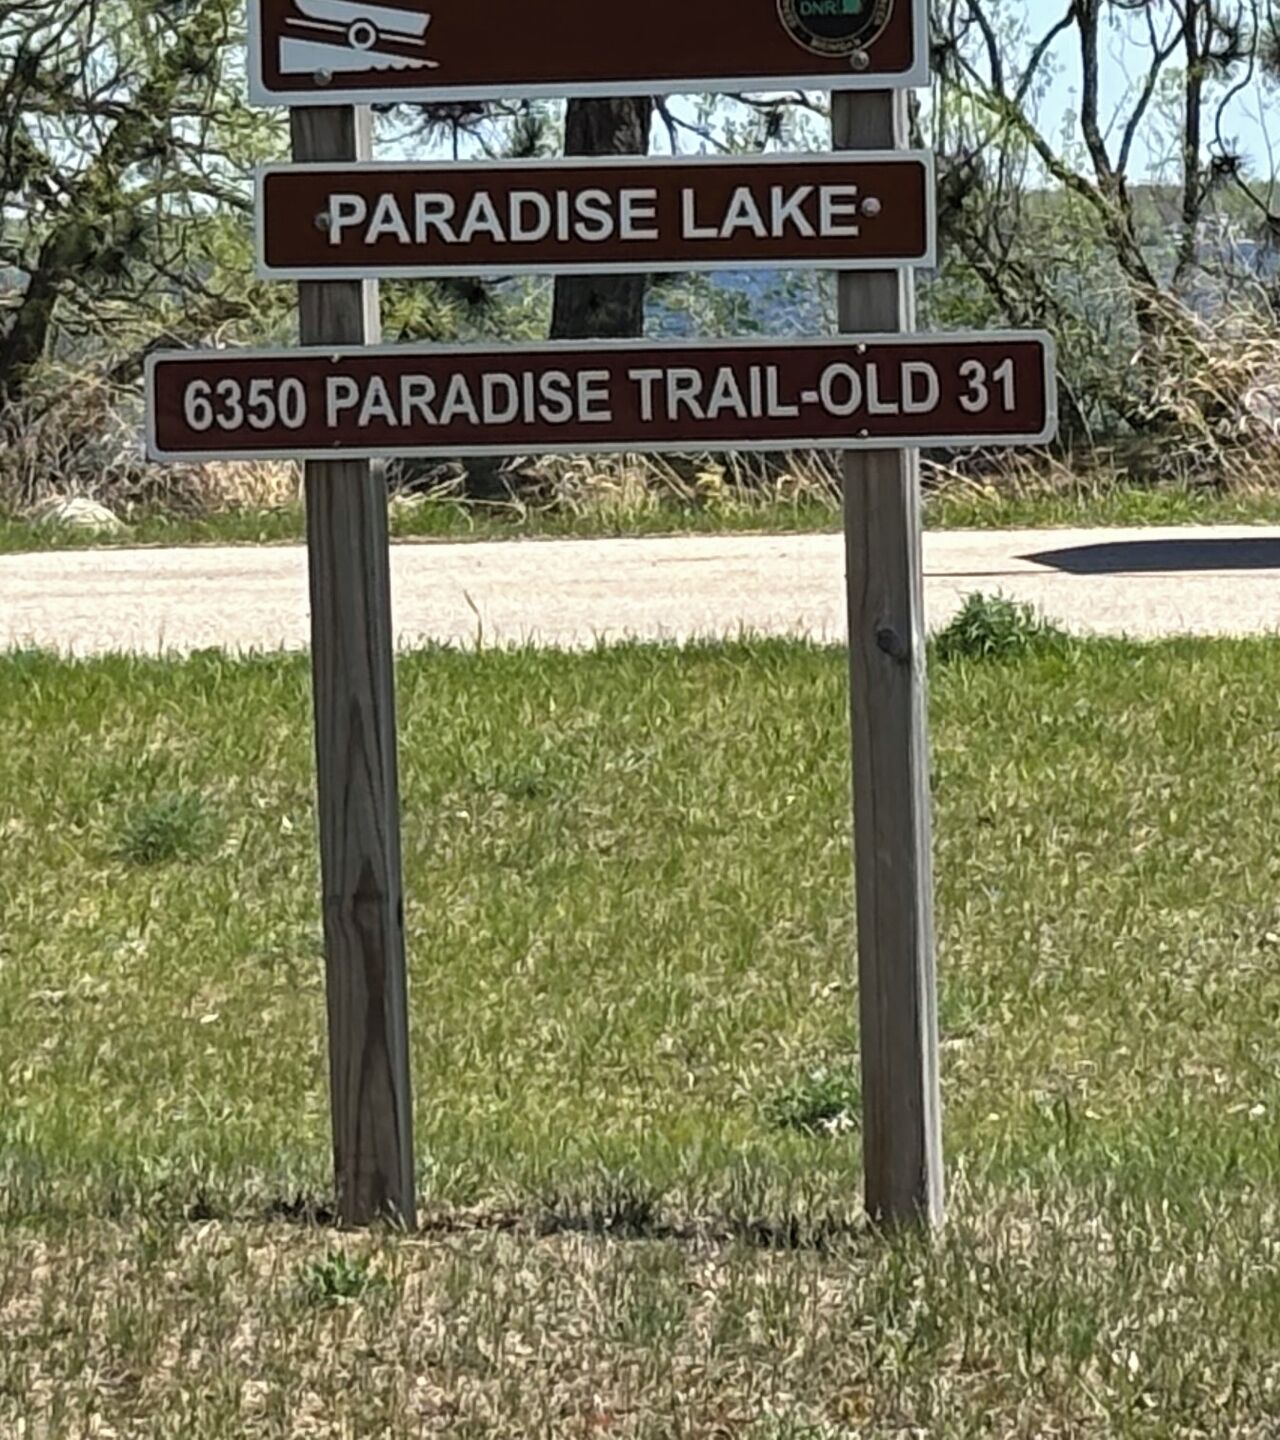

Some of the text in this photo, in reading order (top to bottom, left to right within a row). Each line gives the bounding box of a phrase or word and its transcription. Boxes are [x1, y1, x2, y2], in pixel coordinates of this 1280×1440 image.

[800, 0, 836, 16] DNR
[329, 186, 858, 244] PARADISE LAKE
[185, 359, 1014, 430] 6350 PARADISE TRAIL-OLD 31
